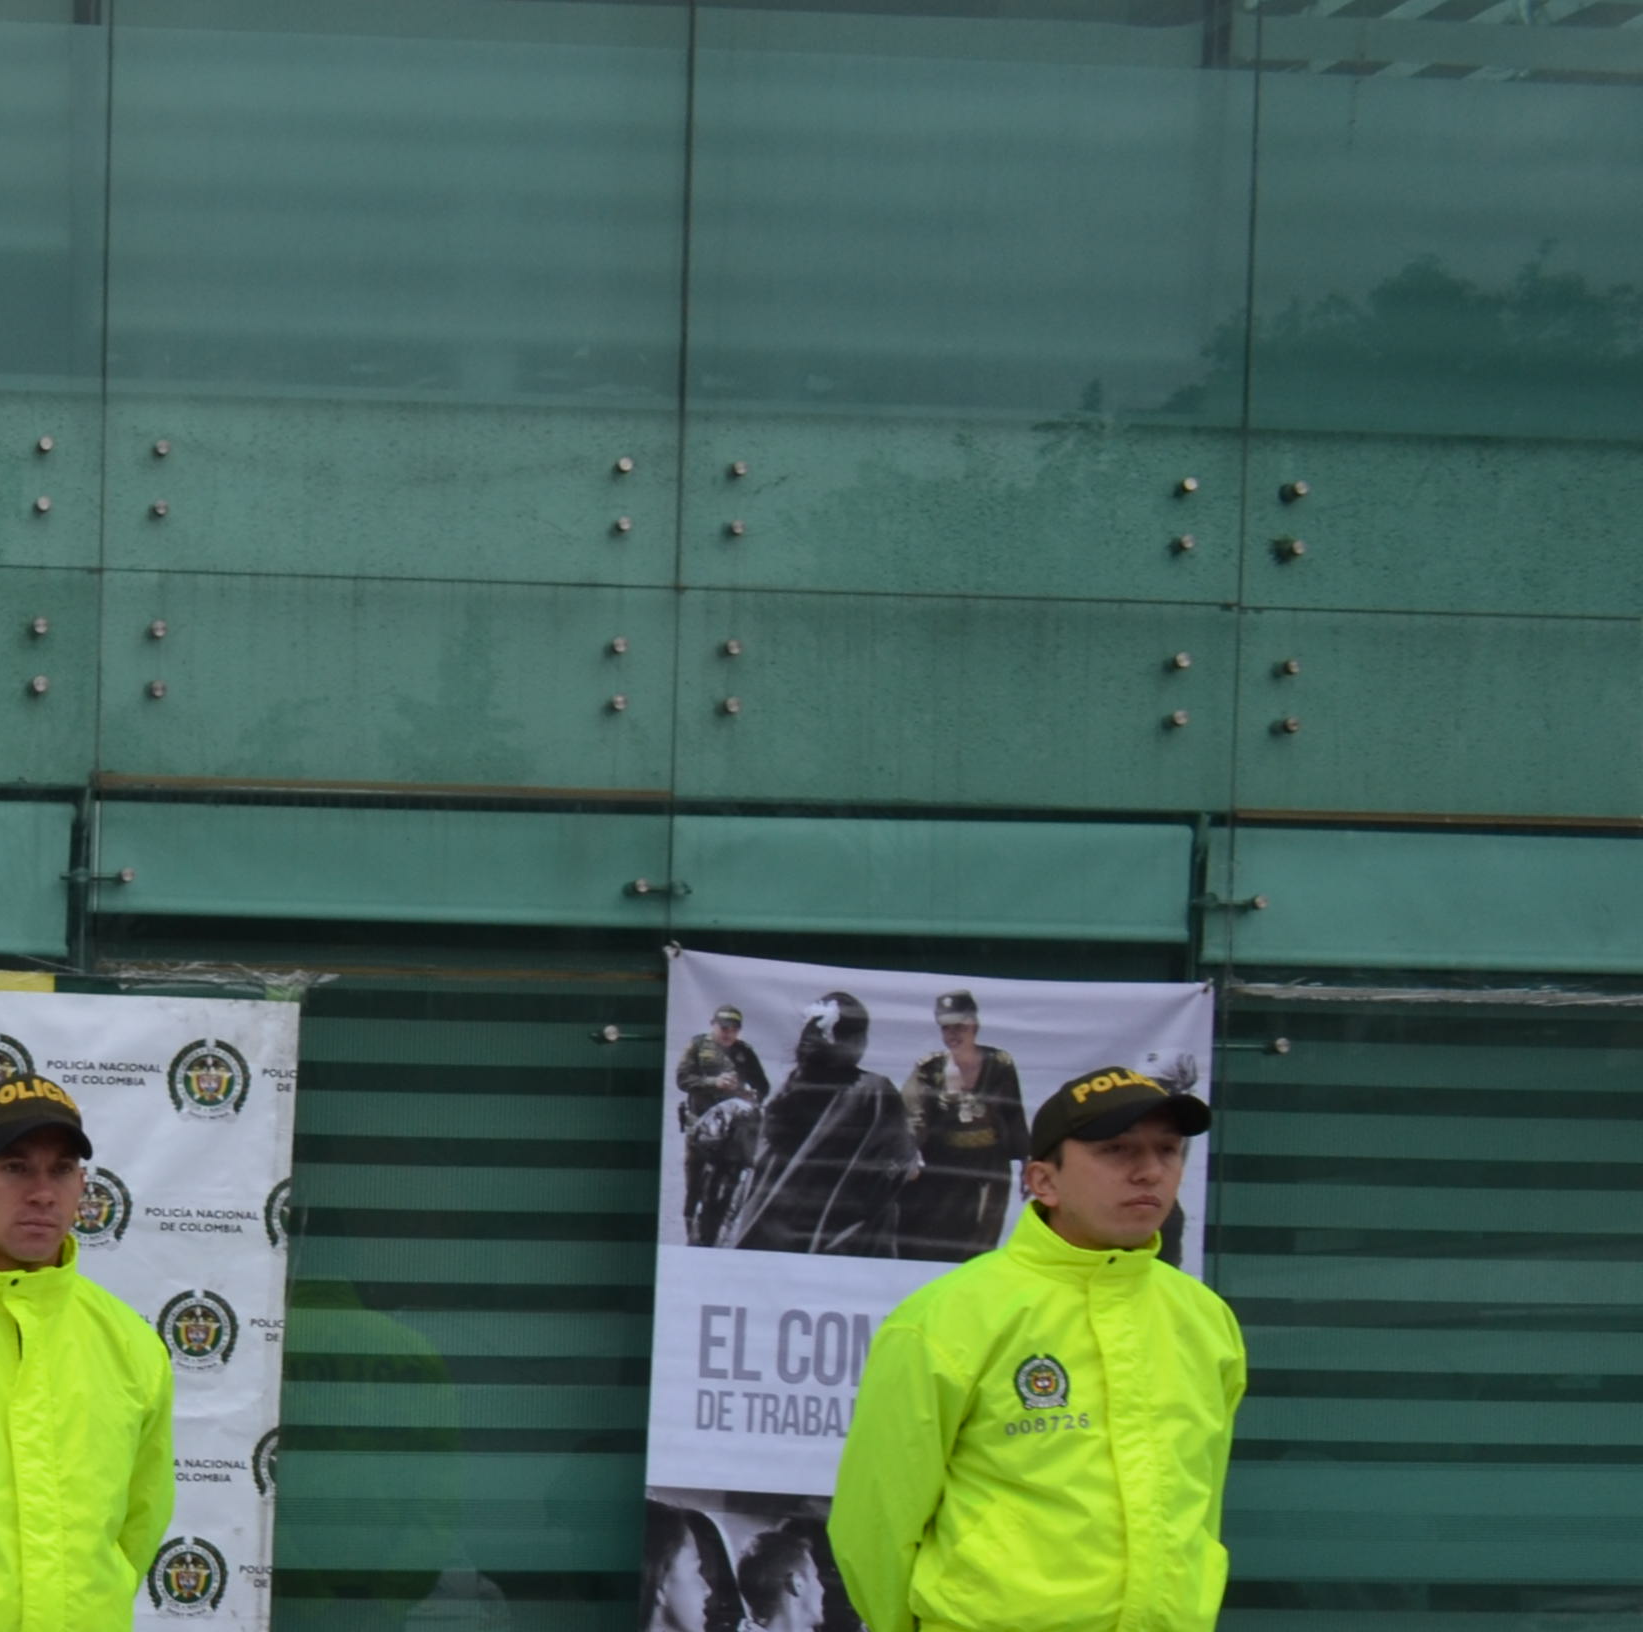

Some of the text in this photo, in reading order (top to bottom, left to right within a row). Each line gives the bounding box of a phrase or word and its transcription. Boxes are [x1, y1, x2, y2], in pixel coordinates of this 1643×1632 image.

[46, 1059, 162, 1074] POLICÍA NACIONAL
[261, 1067, 297, 1080] POLIC
[62, 1074, 146, 1087] DE COLOMBIA
[276, 1082, 293, 1093] DE
[144, 1206, 259, 1221] POLICÍA NACIONAL
[159, 1221, 243, 1234] DE COLOMBIA
[250, 1318, 284, 1329] POLIC
[265, 1332, 280, 1343] DE
[698, 1304, 762, 1382] EL
[696, 1389, 735, 1432] DE
[184, 1459, 248, 1470] NACIONAL
[175, 1472, 232, 1482] OLOMBIA
[239, 1564, 272, 1576] POLIC
[253, 1578, 269, 1589] DE
